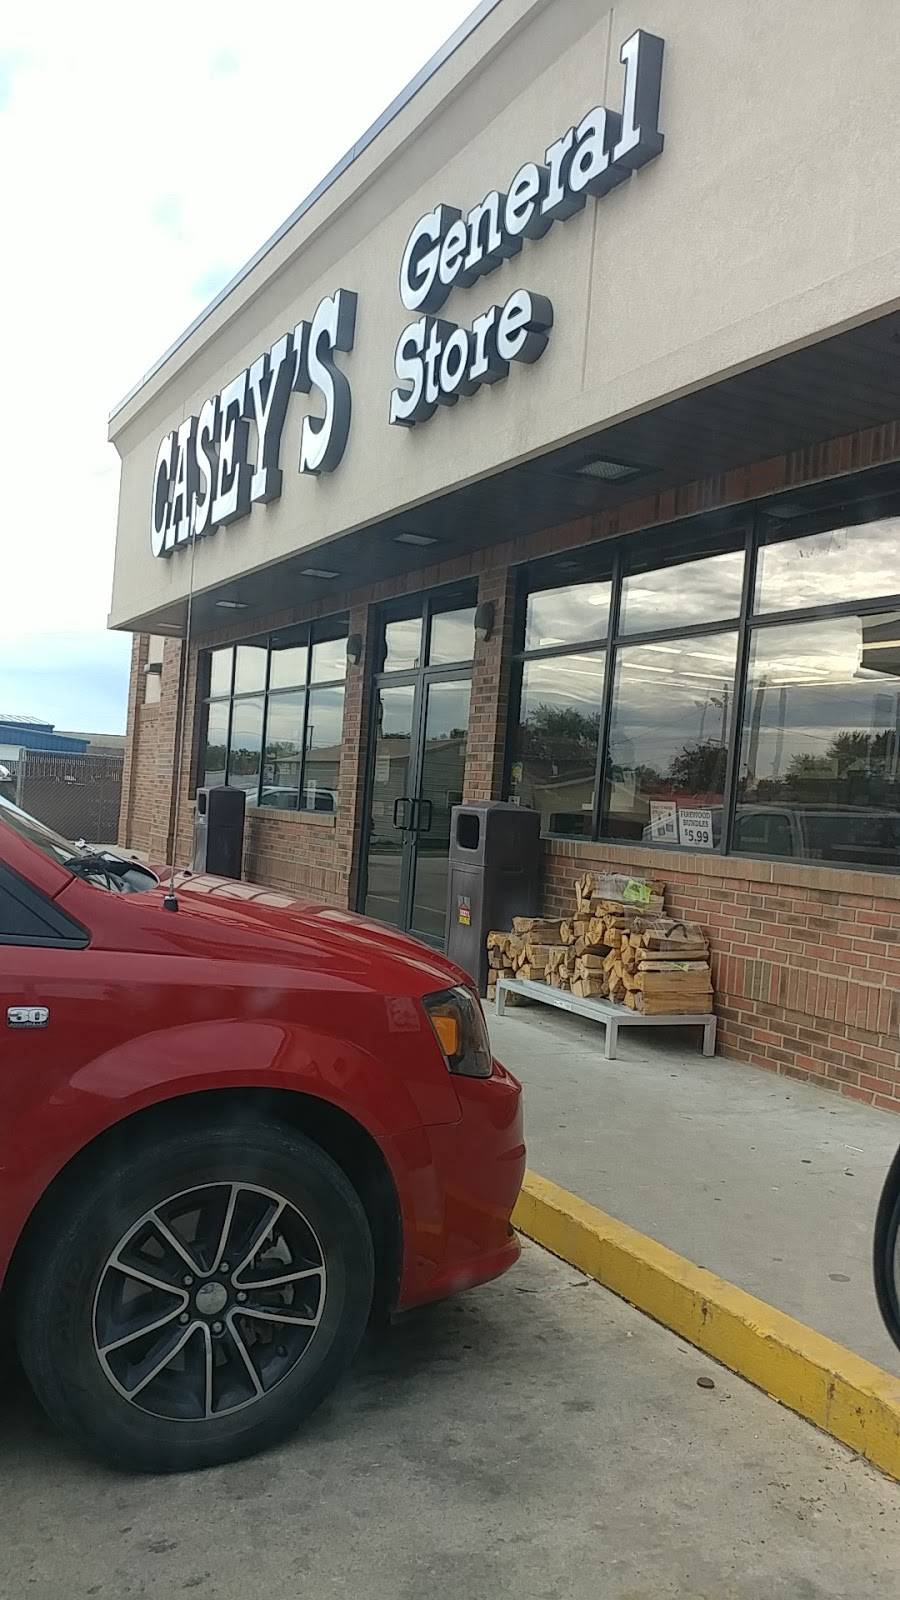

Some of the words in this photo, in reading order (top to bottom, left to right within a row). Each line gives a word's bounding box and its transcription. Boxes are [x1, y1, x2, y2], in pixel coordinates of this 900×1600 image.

[400, 29, 664, 312] General
[151, 288, 358, 558] CASEY'S
[389, 288, 553, 427] Store
